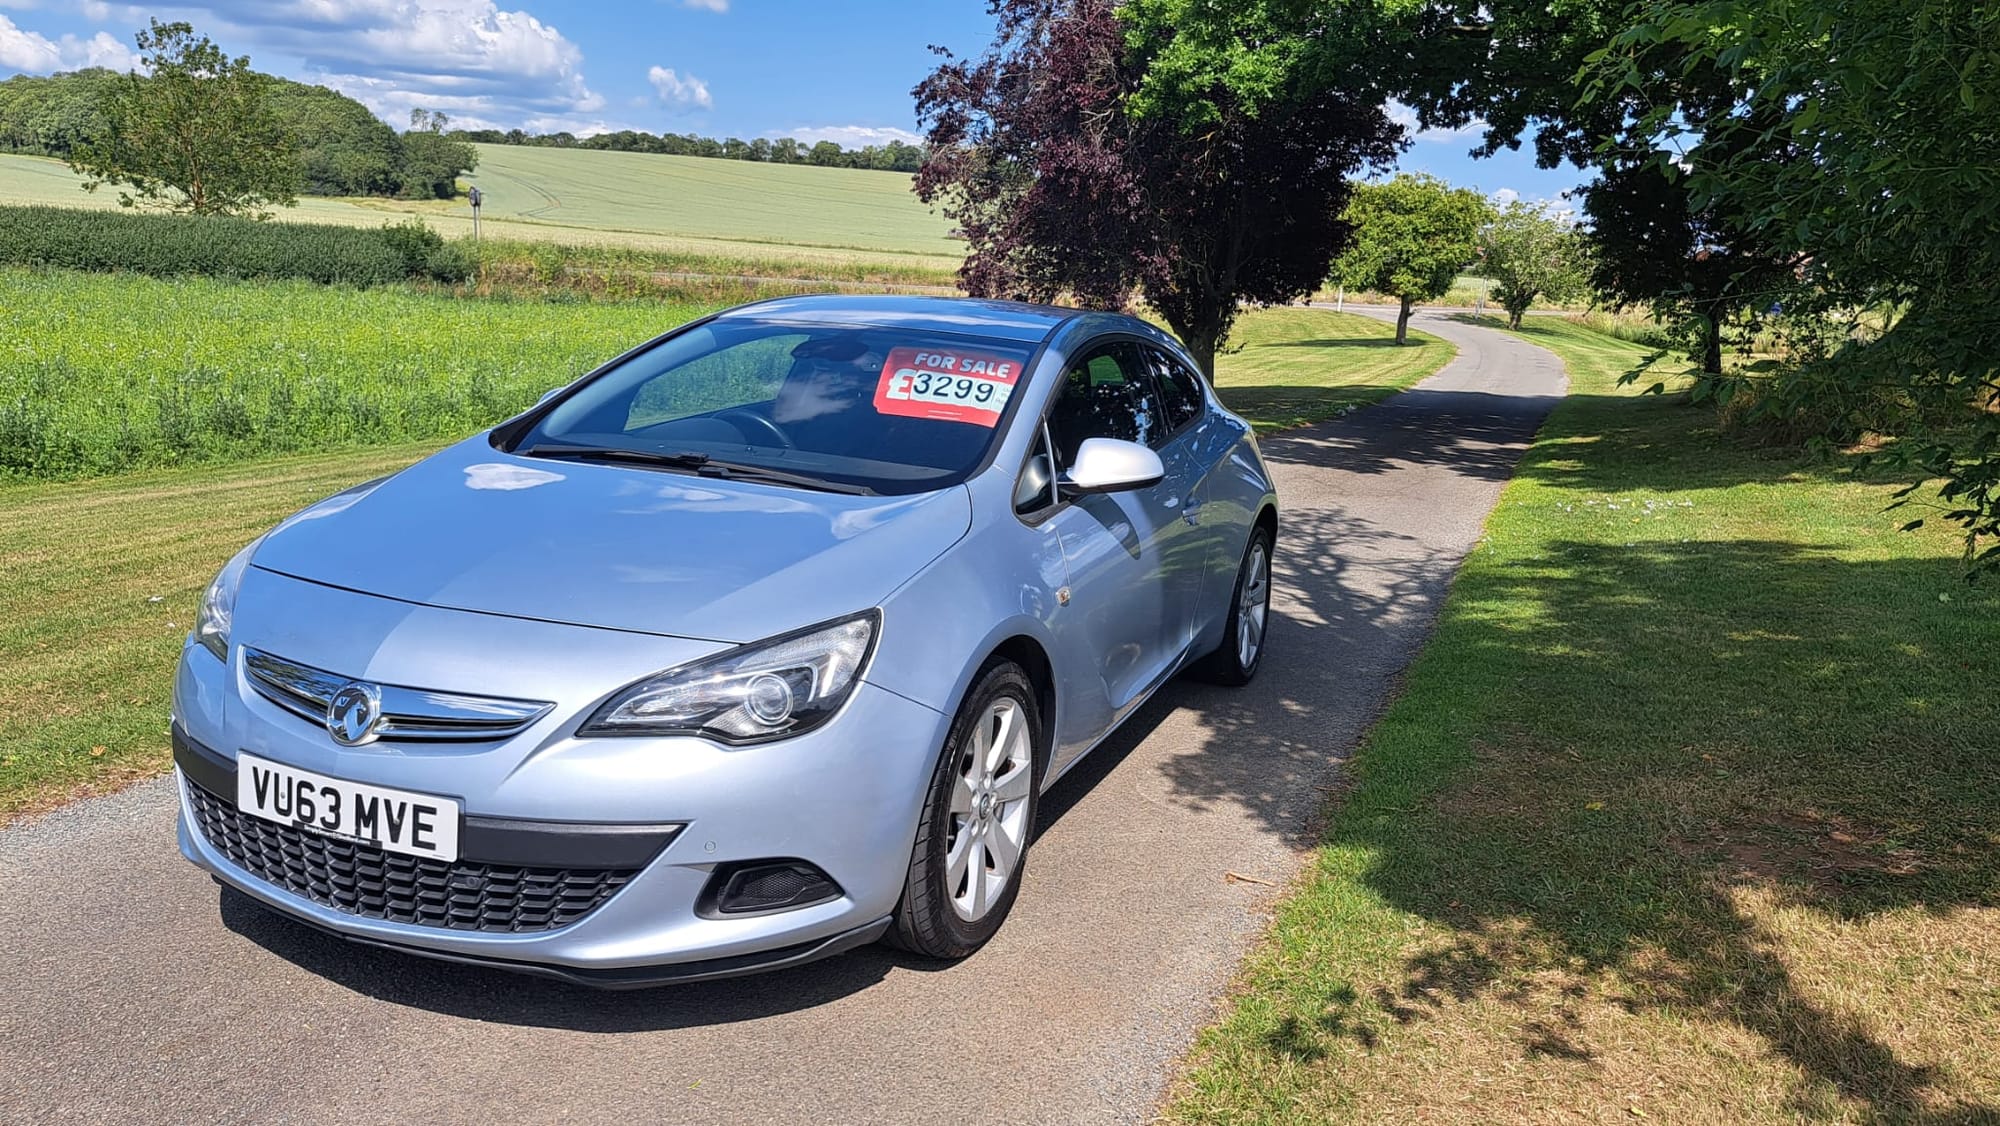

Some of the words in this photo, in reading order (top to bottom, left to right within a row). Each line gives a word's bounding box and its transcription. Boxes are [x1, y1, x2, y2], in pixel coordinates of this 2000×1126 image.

[914, 353, 957, 370] FOR
[960, 359, 1011, 378] SALE
[252, 766, 341, 830] VU63
[355, 793, 437, 851] MVE
